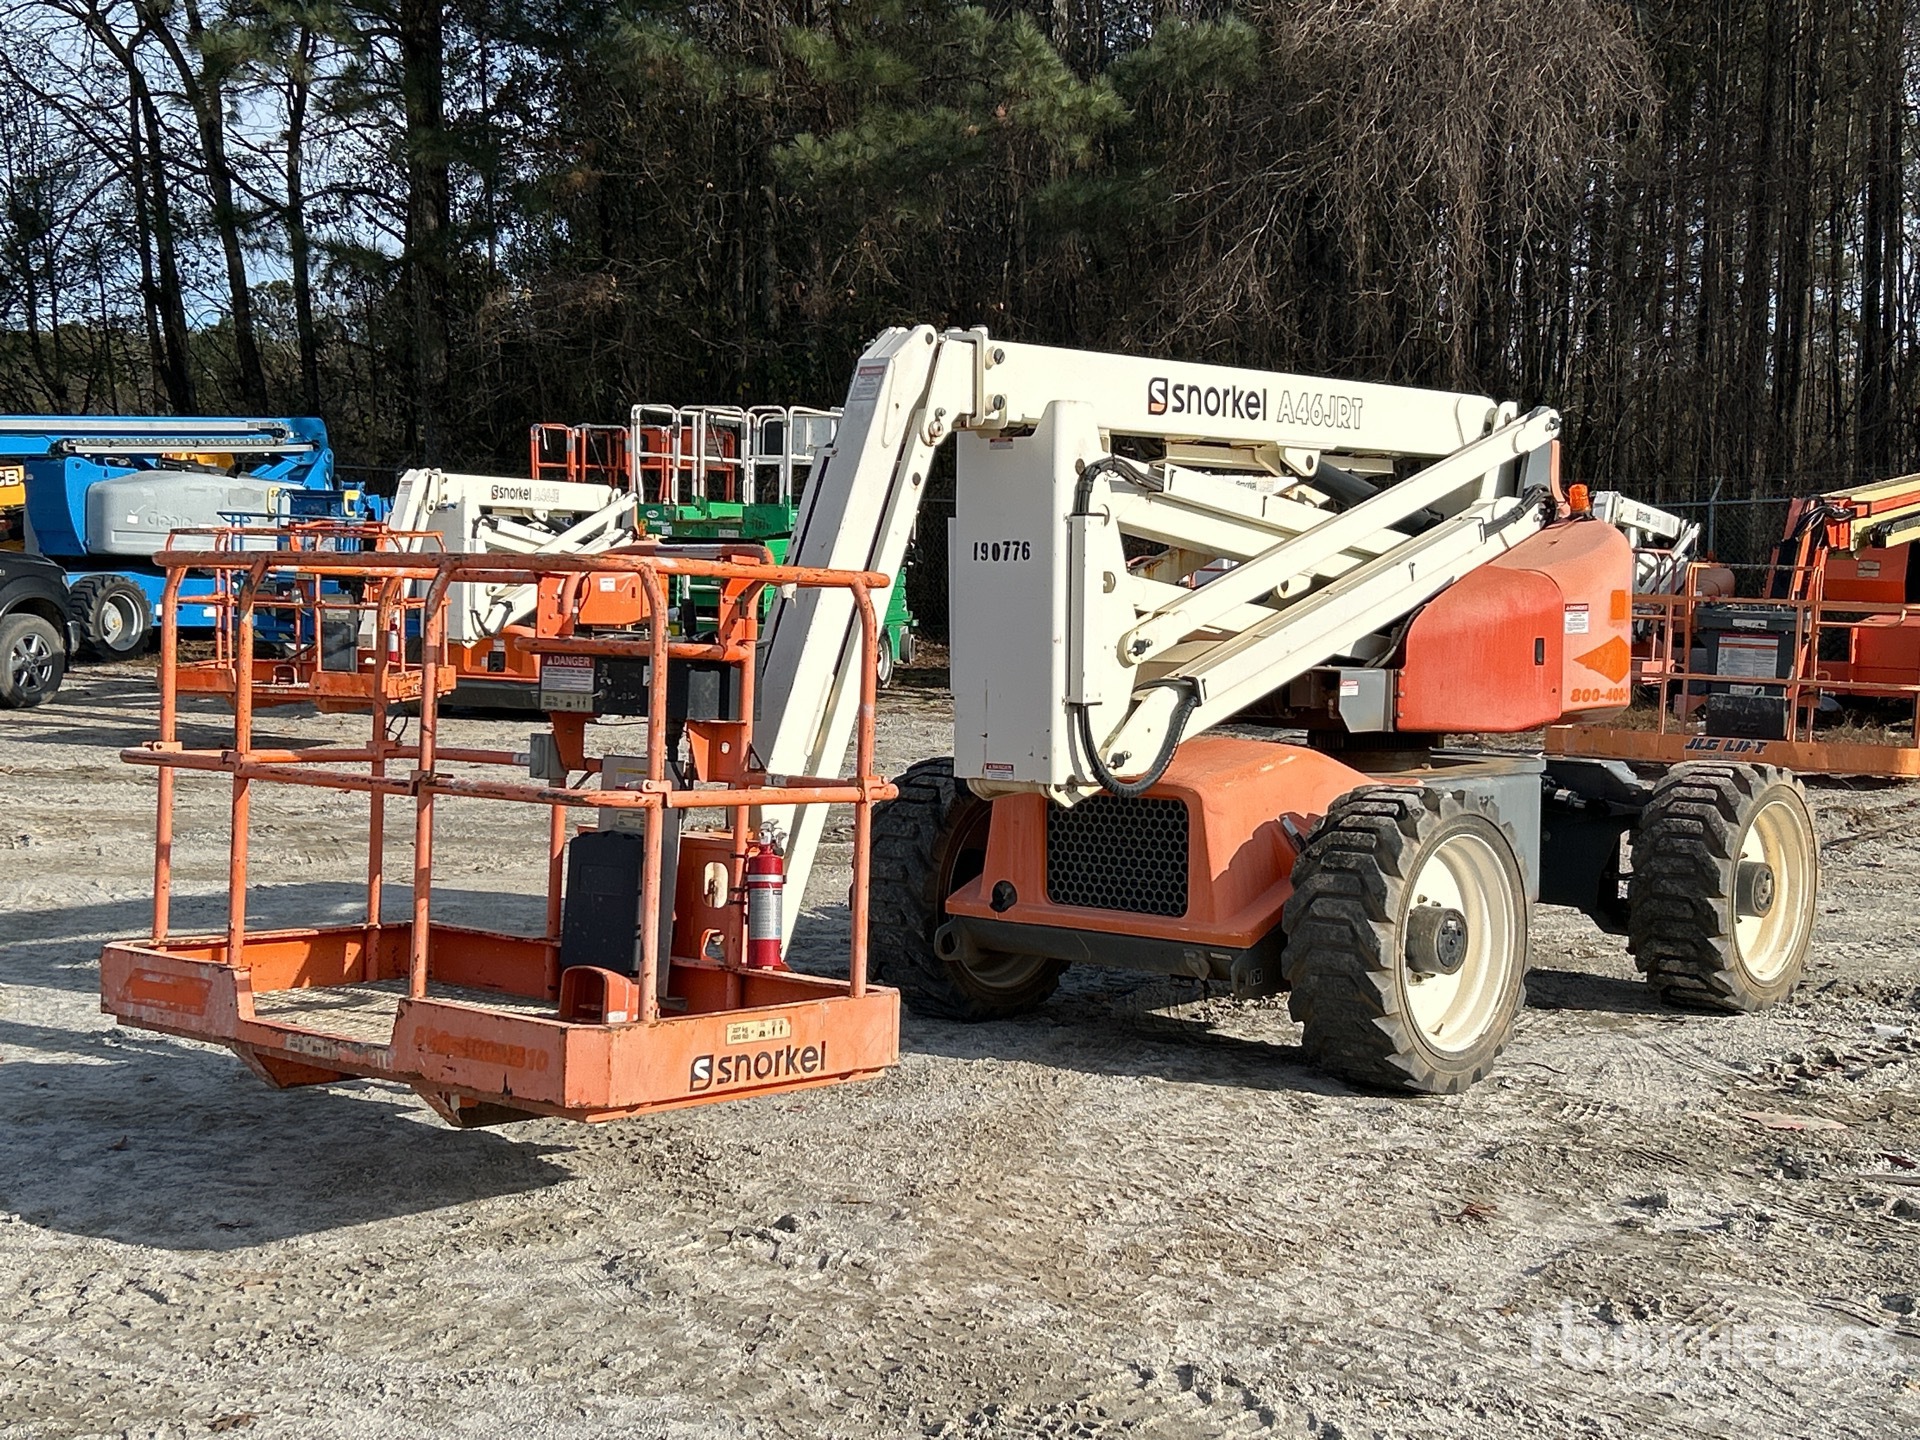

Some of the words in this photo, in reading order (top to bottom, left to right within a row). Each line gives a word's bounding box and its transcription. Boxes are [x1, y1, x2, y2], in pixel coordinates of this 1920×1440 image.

[1172, 383, 1267, 421] snorkel
[1276, 390, 1363, 429] A46JRT
[499, 486, 532, 501] snorkel
[973, 540, 1030, 561] 190776
[554, 655, 590, 666] DANGER
[1685, 738, 1721, 751] JLG
[1723, 739, 1767, 754] LIFT
[717, 1040, 826, 1085] snorkel
